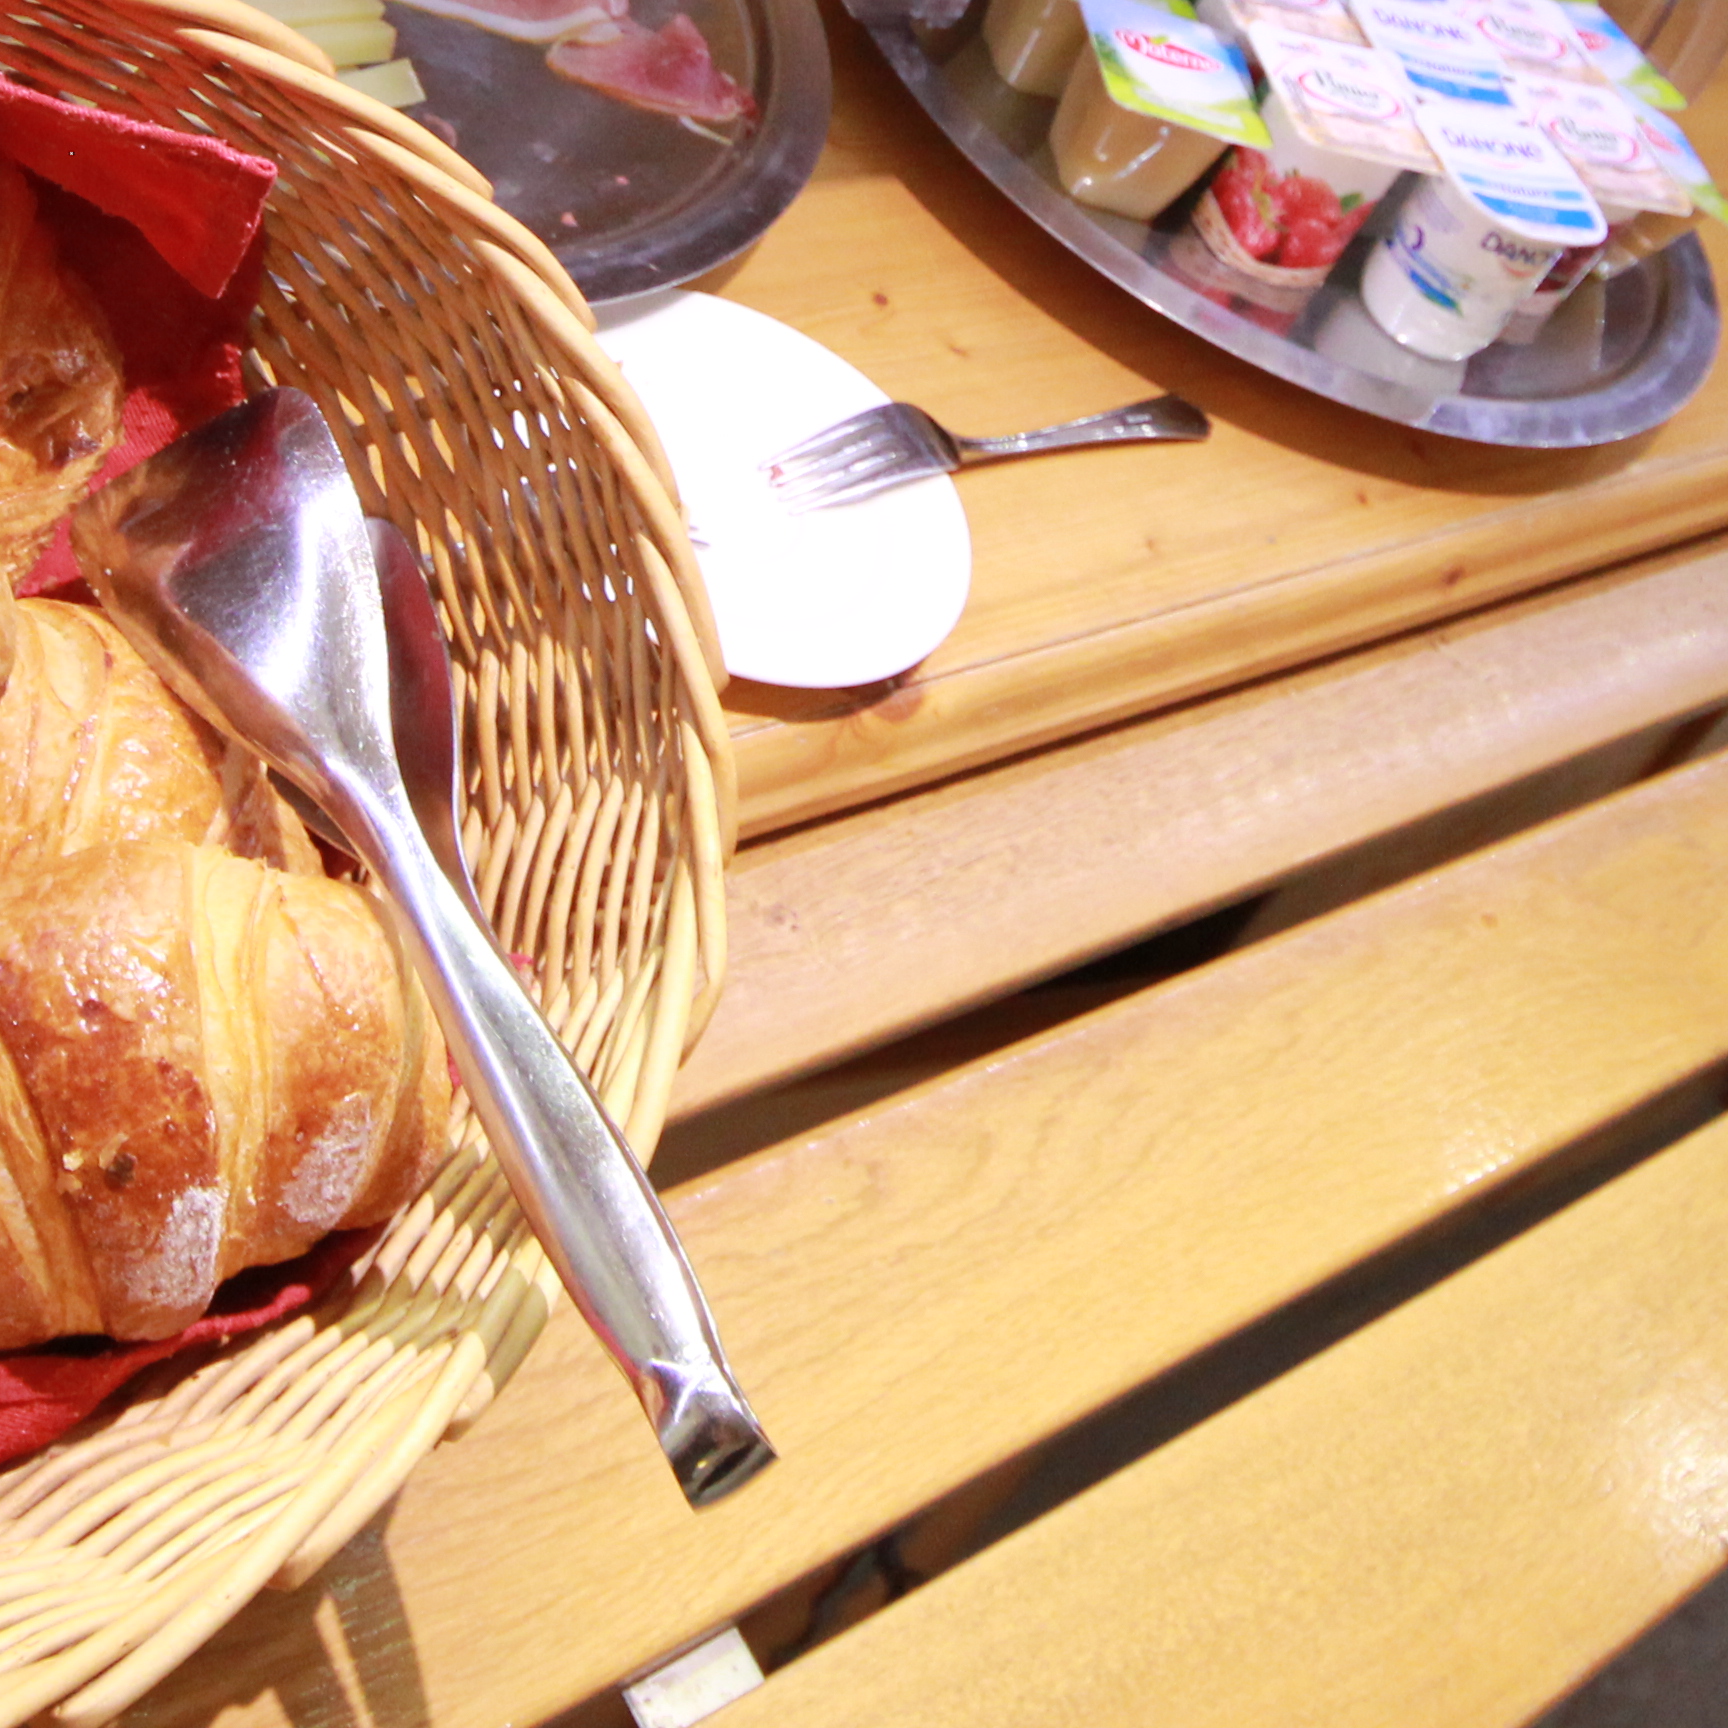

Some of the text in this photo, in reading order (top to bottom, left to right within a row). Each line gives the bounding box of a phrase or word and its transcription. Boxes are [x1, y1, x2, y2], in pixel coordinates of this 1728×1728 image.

[1373, 8, 1466, 40] DANONE
[1116, 29, 1222, 73] Materne
[1443, 127, 1541, 160] DANONE
